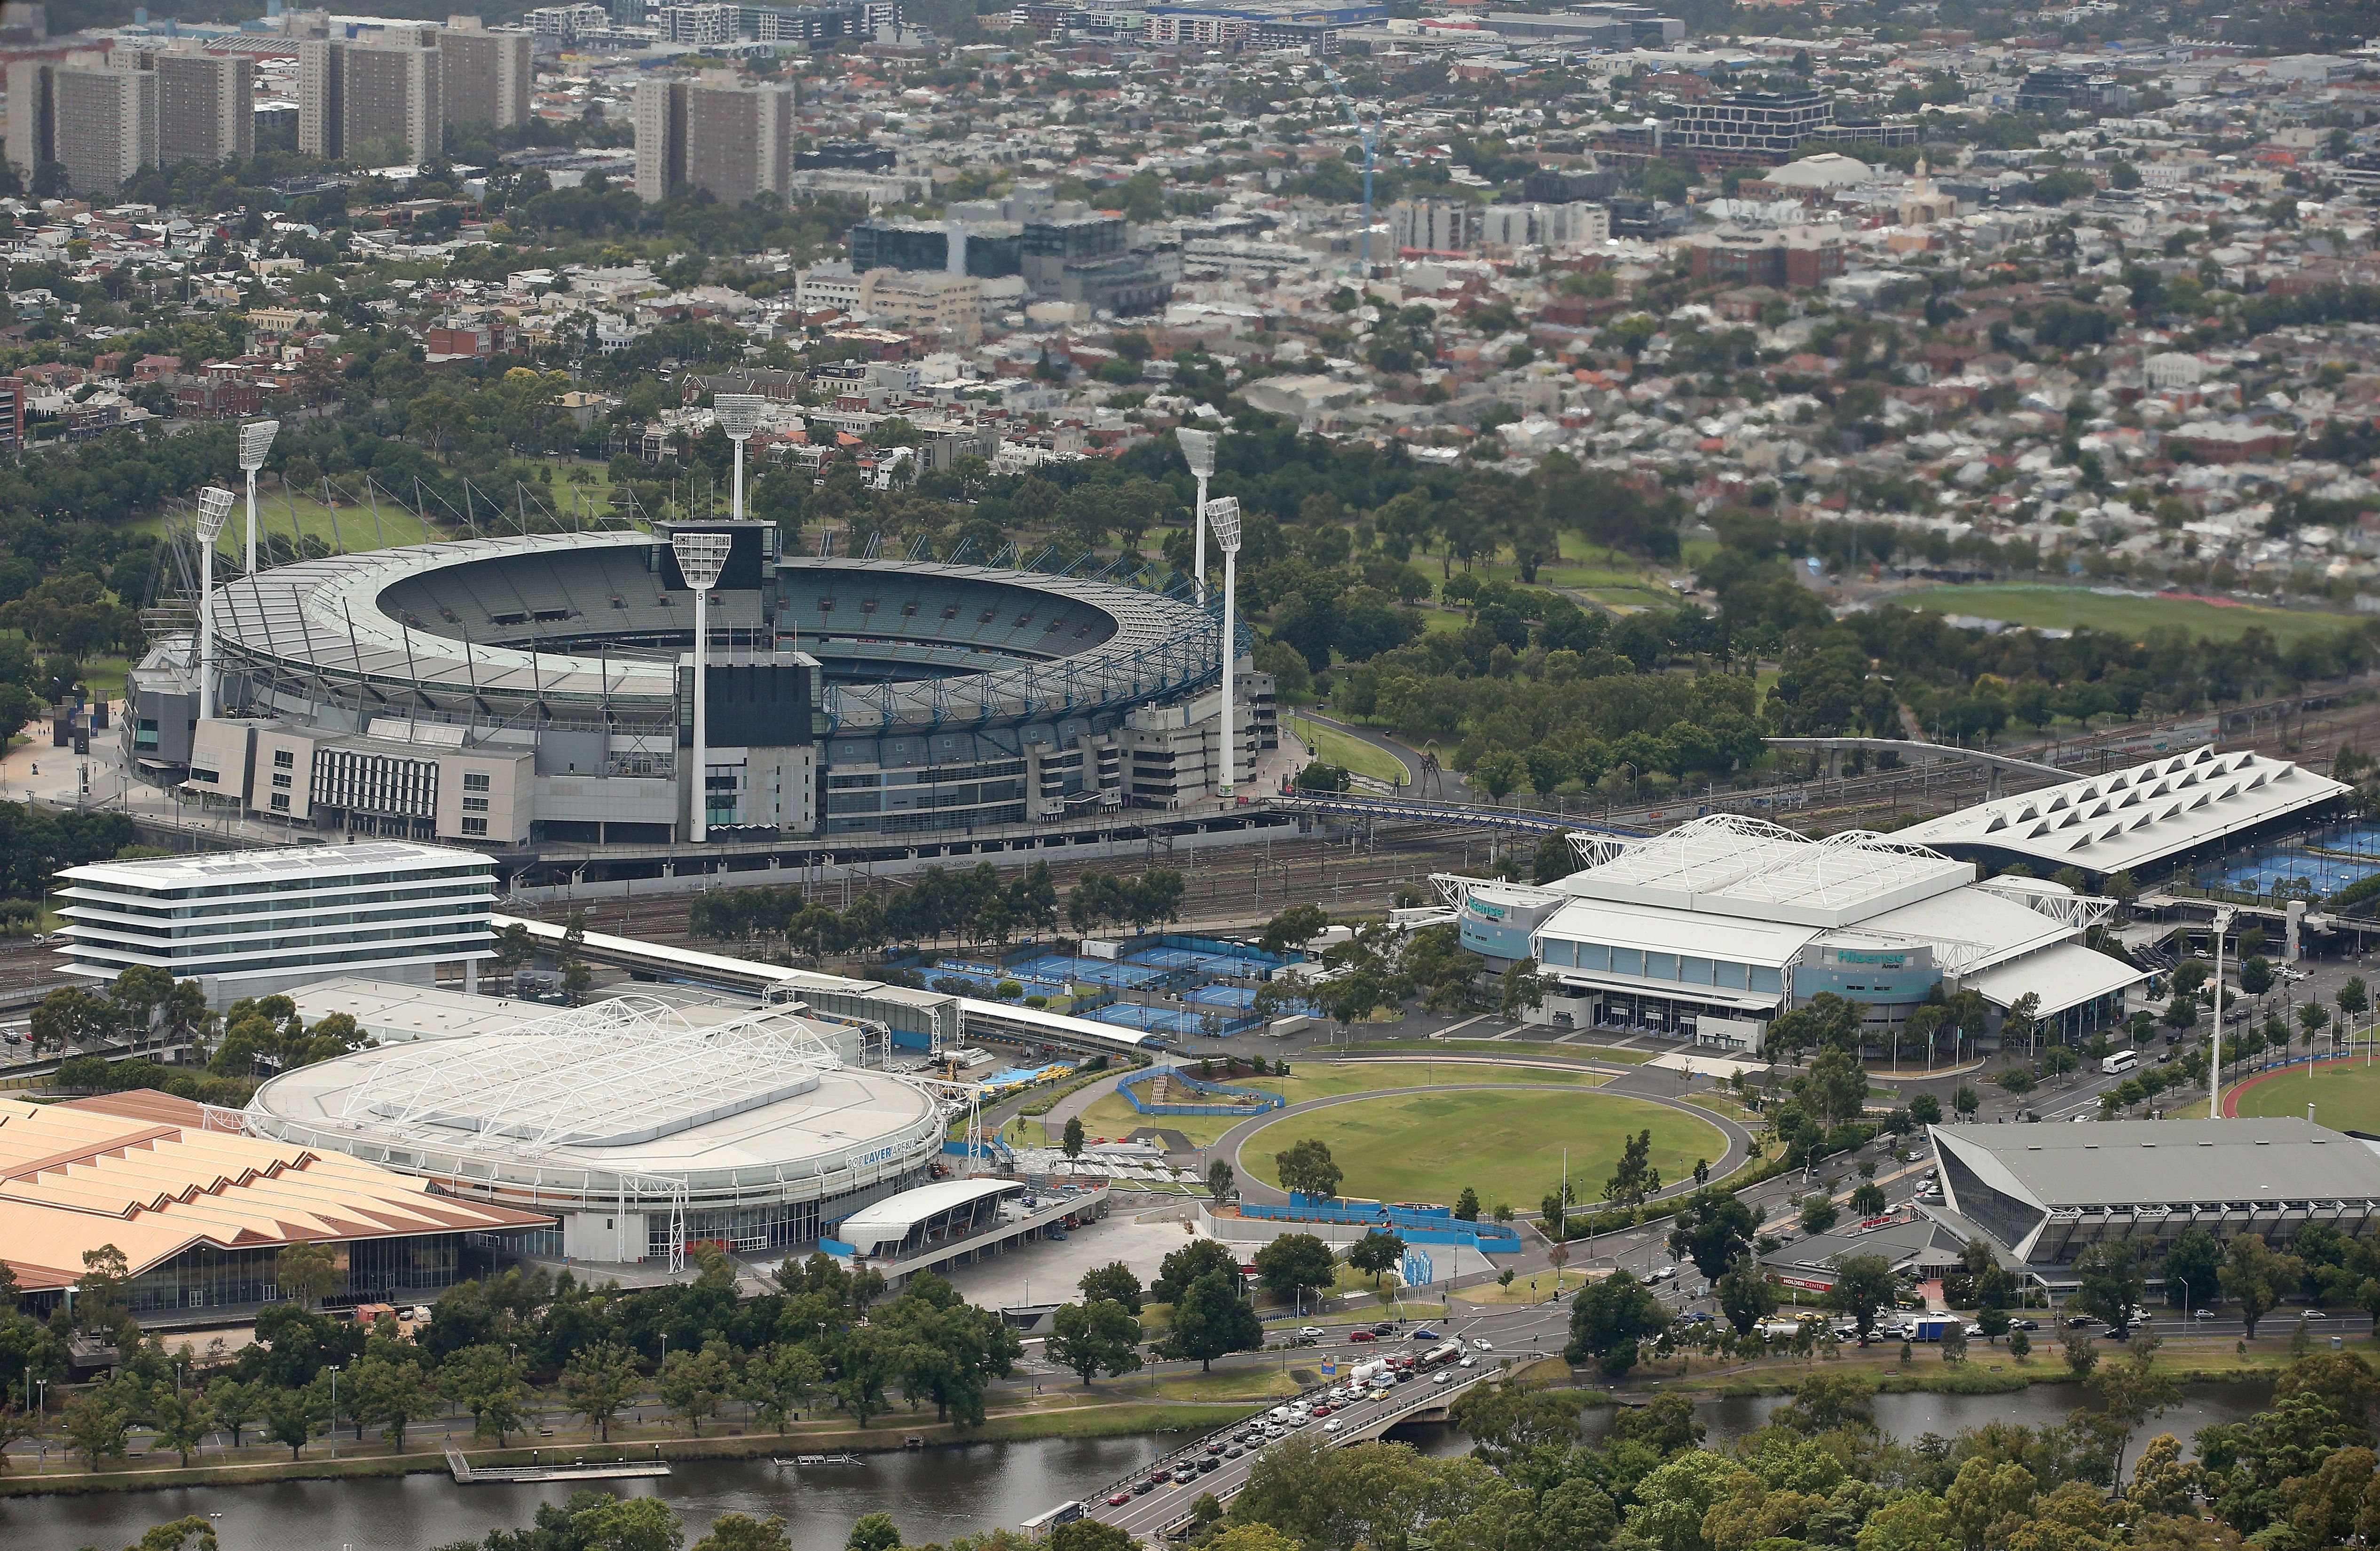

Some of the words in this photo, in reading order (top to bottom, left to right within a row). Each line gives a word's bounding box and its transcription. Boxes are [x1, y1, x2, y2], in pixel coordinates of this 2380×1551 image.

[1837, 950, 1906, 963] Hisense
[864, 1147, 891, 1164] LAVER
[892, 1140, 917, 1156] ARENA
